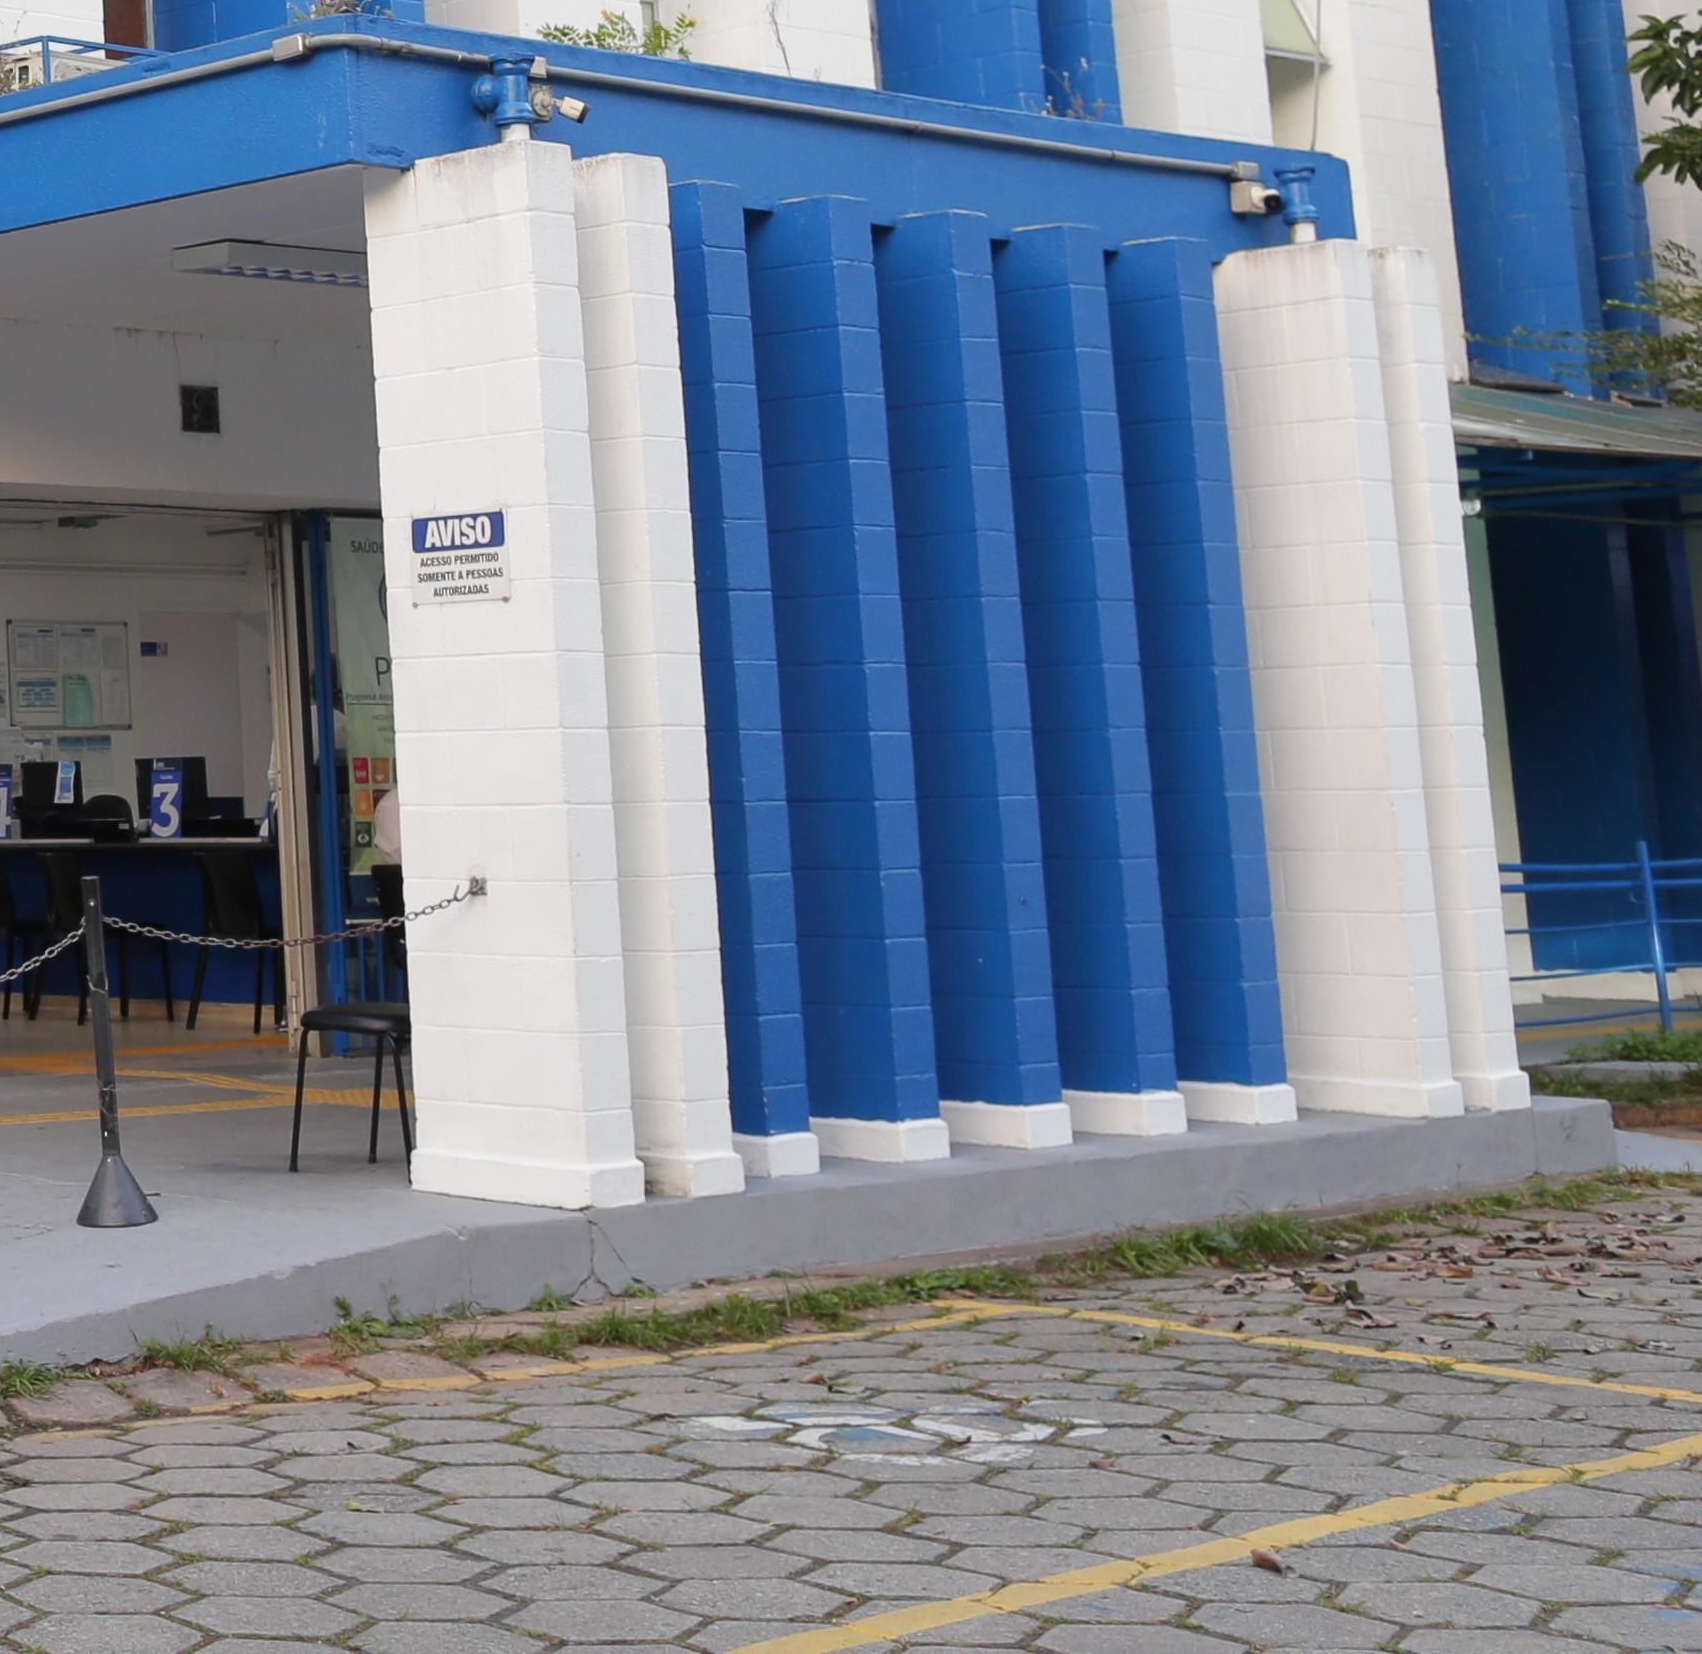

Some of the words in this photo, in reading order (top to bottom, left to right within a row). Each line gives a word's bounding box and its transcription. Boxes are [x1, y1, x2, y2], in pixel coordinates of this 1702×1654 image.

[424, 515, 492, 548] AVISO
[420, 556, 452, 568] ACESSO
[454, 552, 499, 565] PERMITIDO
[417, 570, 456, 583] SOMENTE
[458, 570, 464, 581] A
[466, 567, 503, 580] PESSOAS
[433, 584, 489, 597] AUTORIZADAS
[152, 783, 179, 837] 3
